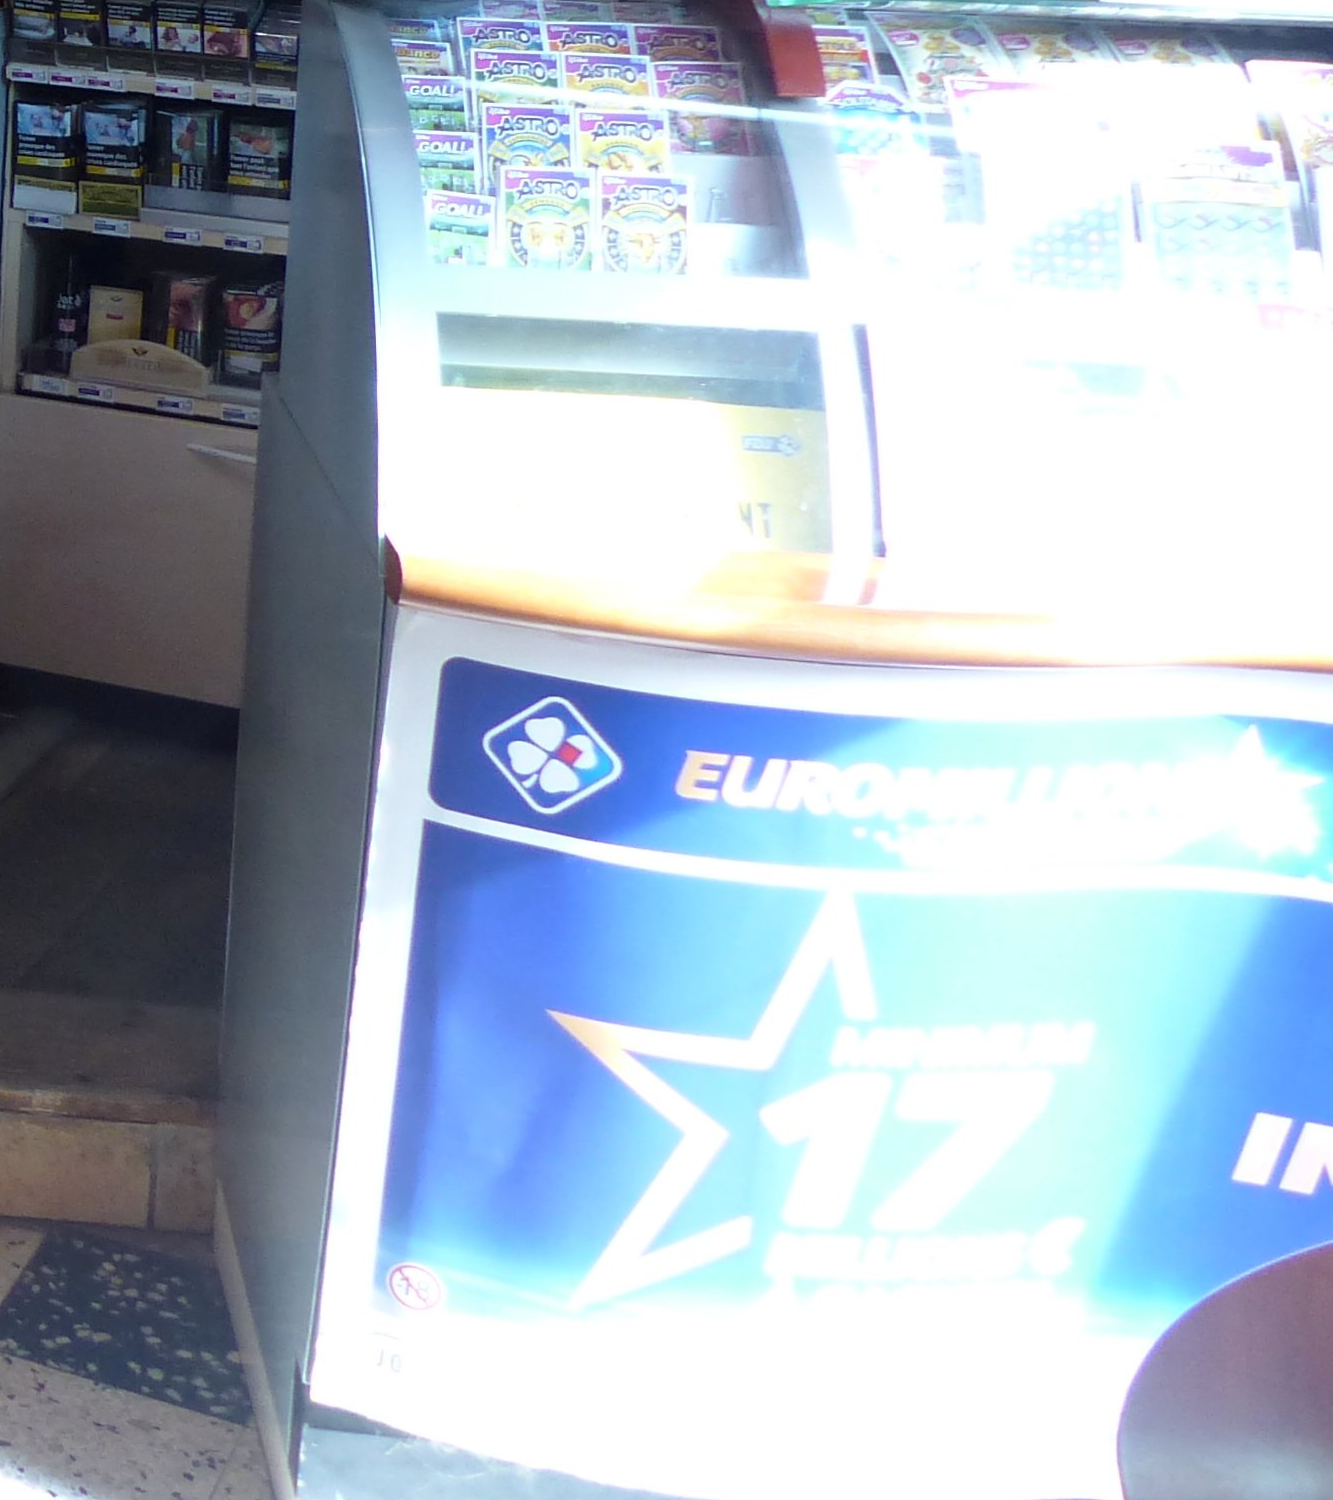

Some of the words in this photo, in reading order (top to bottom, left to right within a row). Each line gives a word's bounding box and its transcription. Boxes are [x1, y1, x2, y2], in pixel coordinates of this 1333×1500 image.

[473, 27, 531, 43] ASTRO
[559, 31, 617, 48] ASTRO
[487, 61, 546, 81] ASTRO
[578, 64, 637, 83] ASTRO
[668, 72, 729, 89] ASTRO
[409, 84, 455, 98] GOAL!
[497, 117, 558, 136] ASTRO
[593, 123, 652, 141] ASTRO
[419, 140, 467, 154] GOAL!
[517, 180, 578, 199] ASTRO
[614, 186, 675, 205] ASTRO
[435, 202, 484, 217] GOAL!
[760, 1070, 1055, 1232] 17
